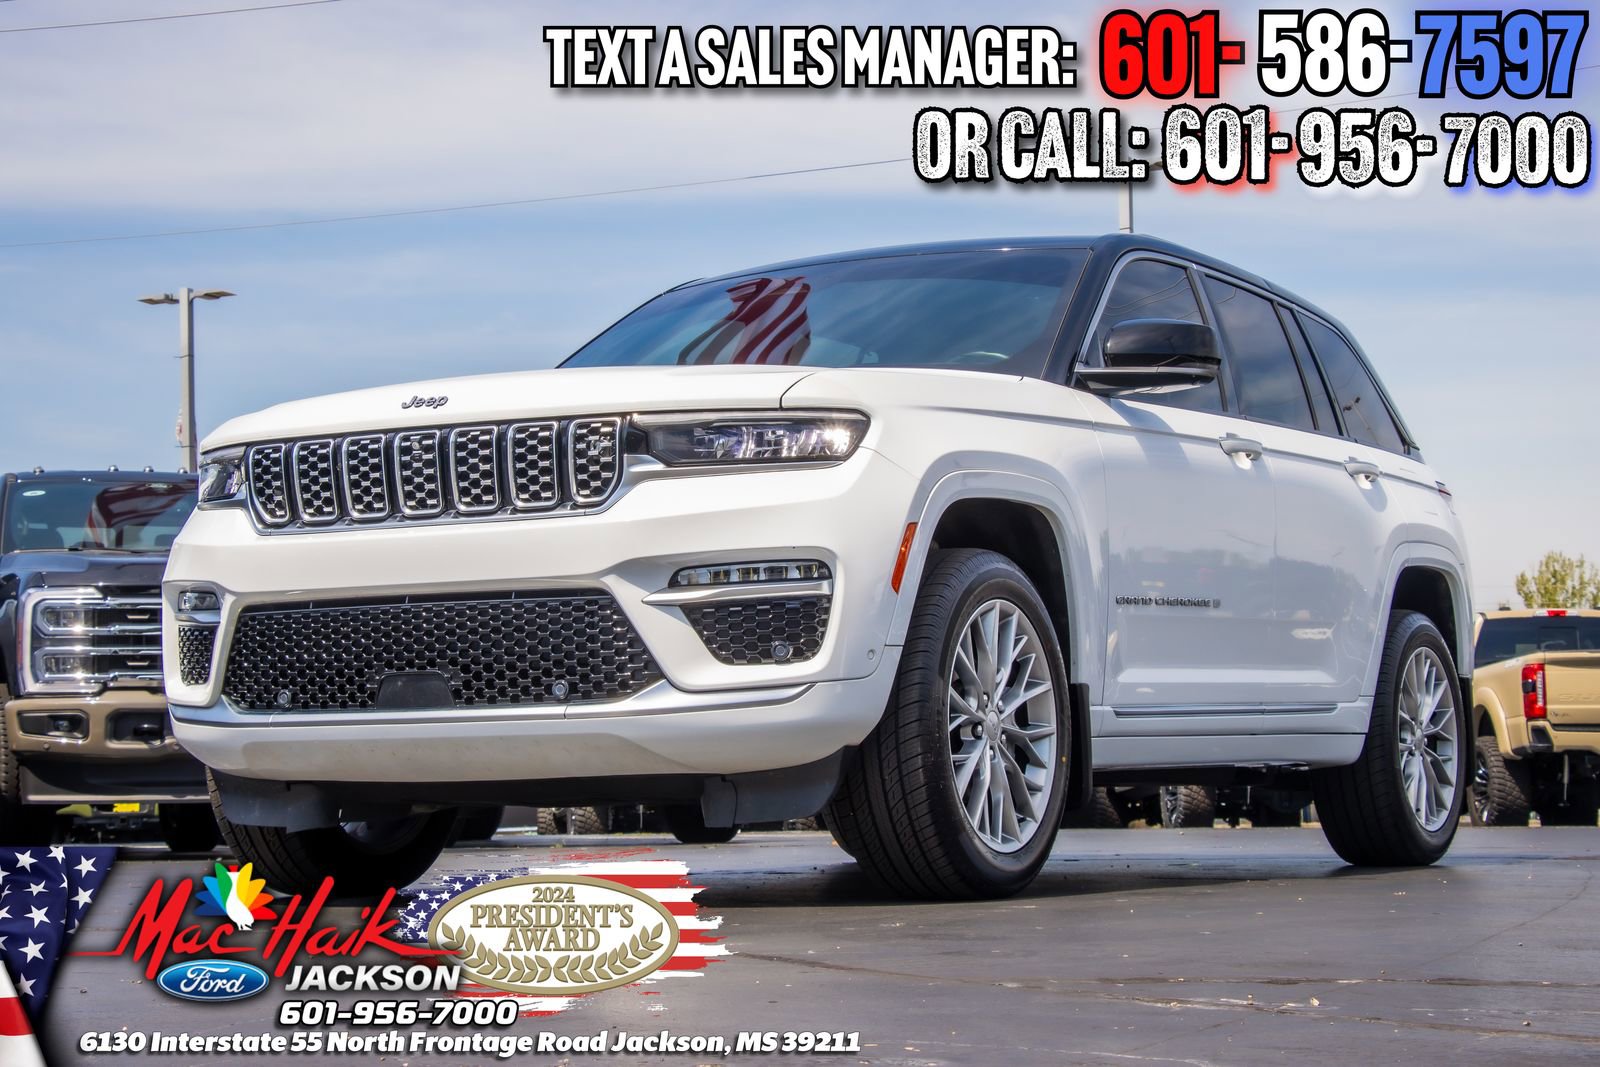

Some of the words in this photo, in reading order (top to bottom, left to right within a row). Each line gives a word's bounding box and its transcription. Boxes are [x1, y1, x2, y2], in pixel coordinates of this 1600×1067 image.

[401, 395, 449, 409] Jeep
[1115, 596, 1153, 606] GRAND
[1154, 597, 1211, 608] CHEROKEE
